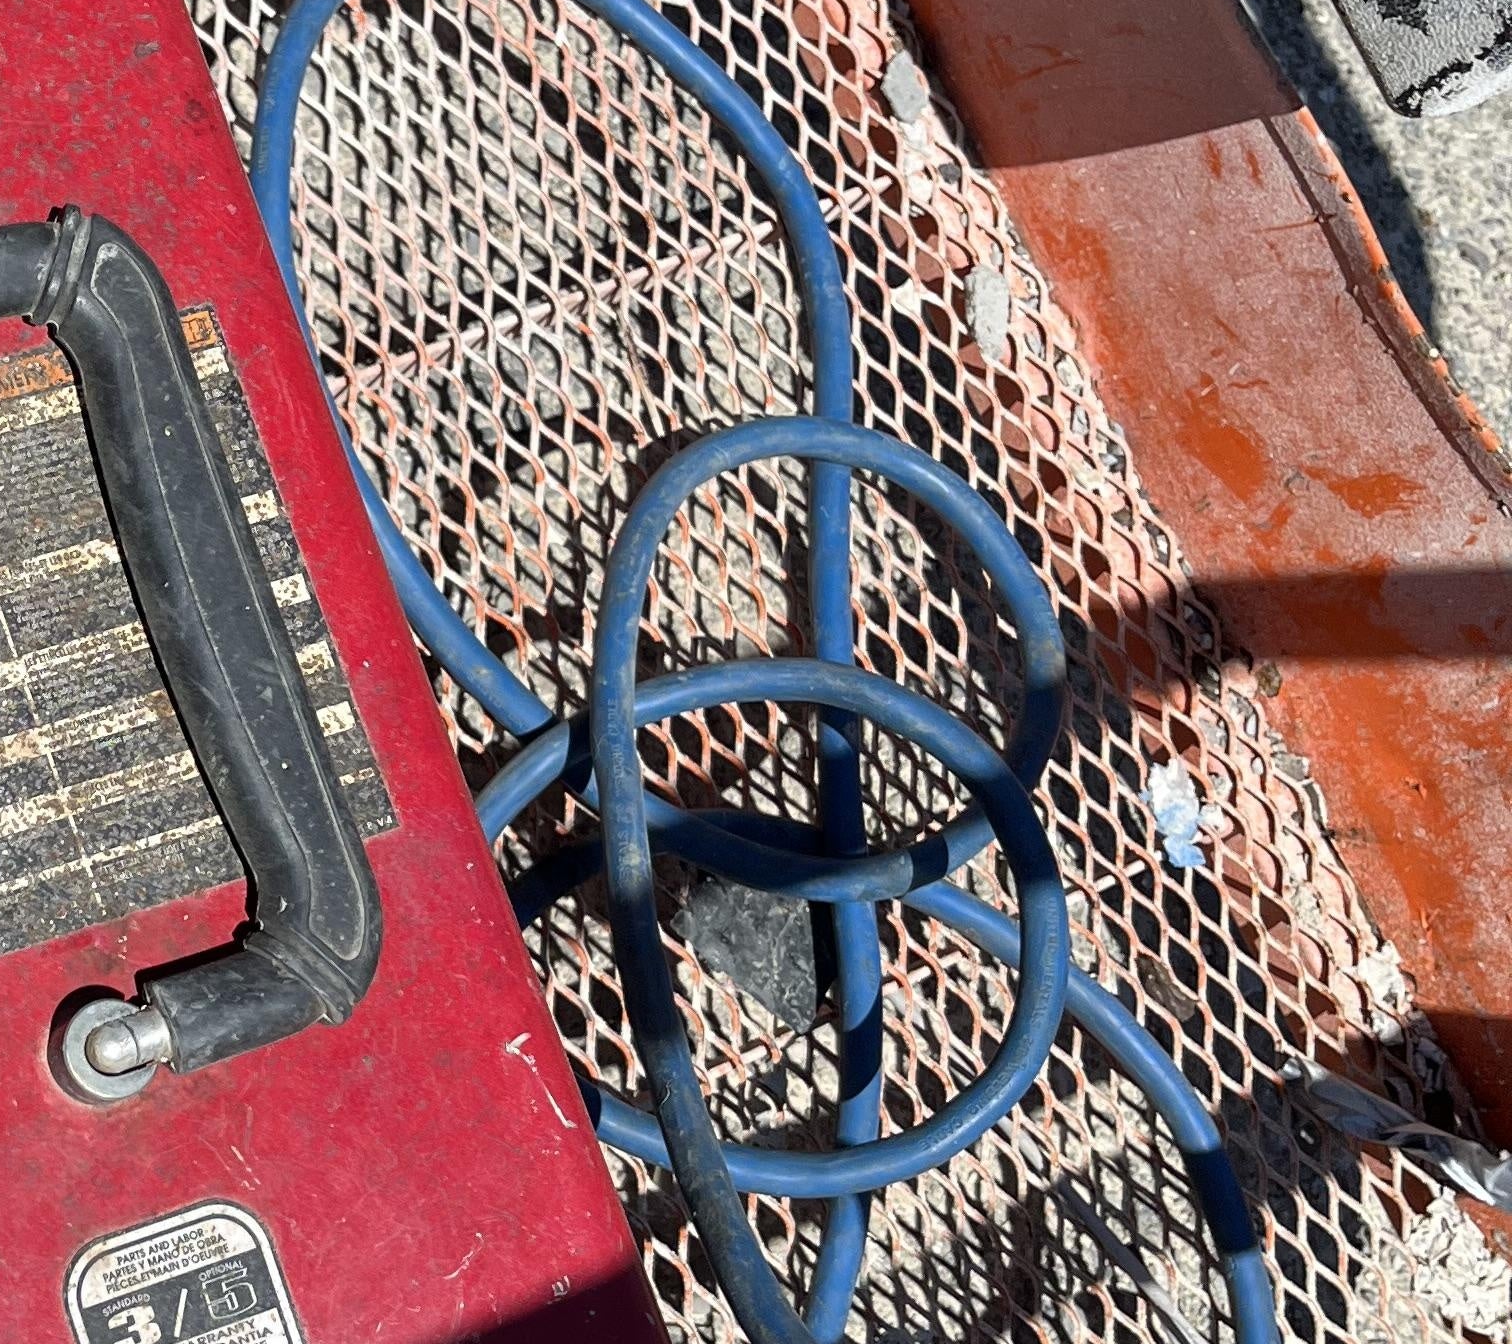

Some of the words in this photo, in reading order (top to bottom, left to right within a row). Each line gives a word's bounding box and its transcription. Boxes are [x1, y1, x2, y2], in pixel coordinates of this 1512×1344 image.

[103, 1263, 138, 1283] PARTES
[148, 1249, 180, 1266] MANO
[182, 1243, 196, 1256] DE
[198, 1233, 226, 1250] OBRA
[117, 1248, 146, 1266] PARTS
[149, 1240, 170, 1257] AND
[172, 1228, 204, 1252] LABOR
[102, 1293, 151, 1317] STANDARD
